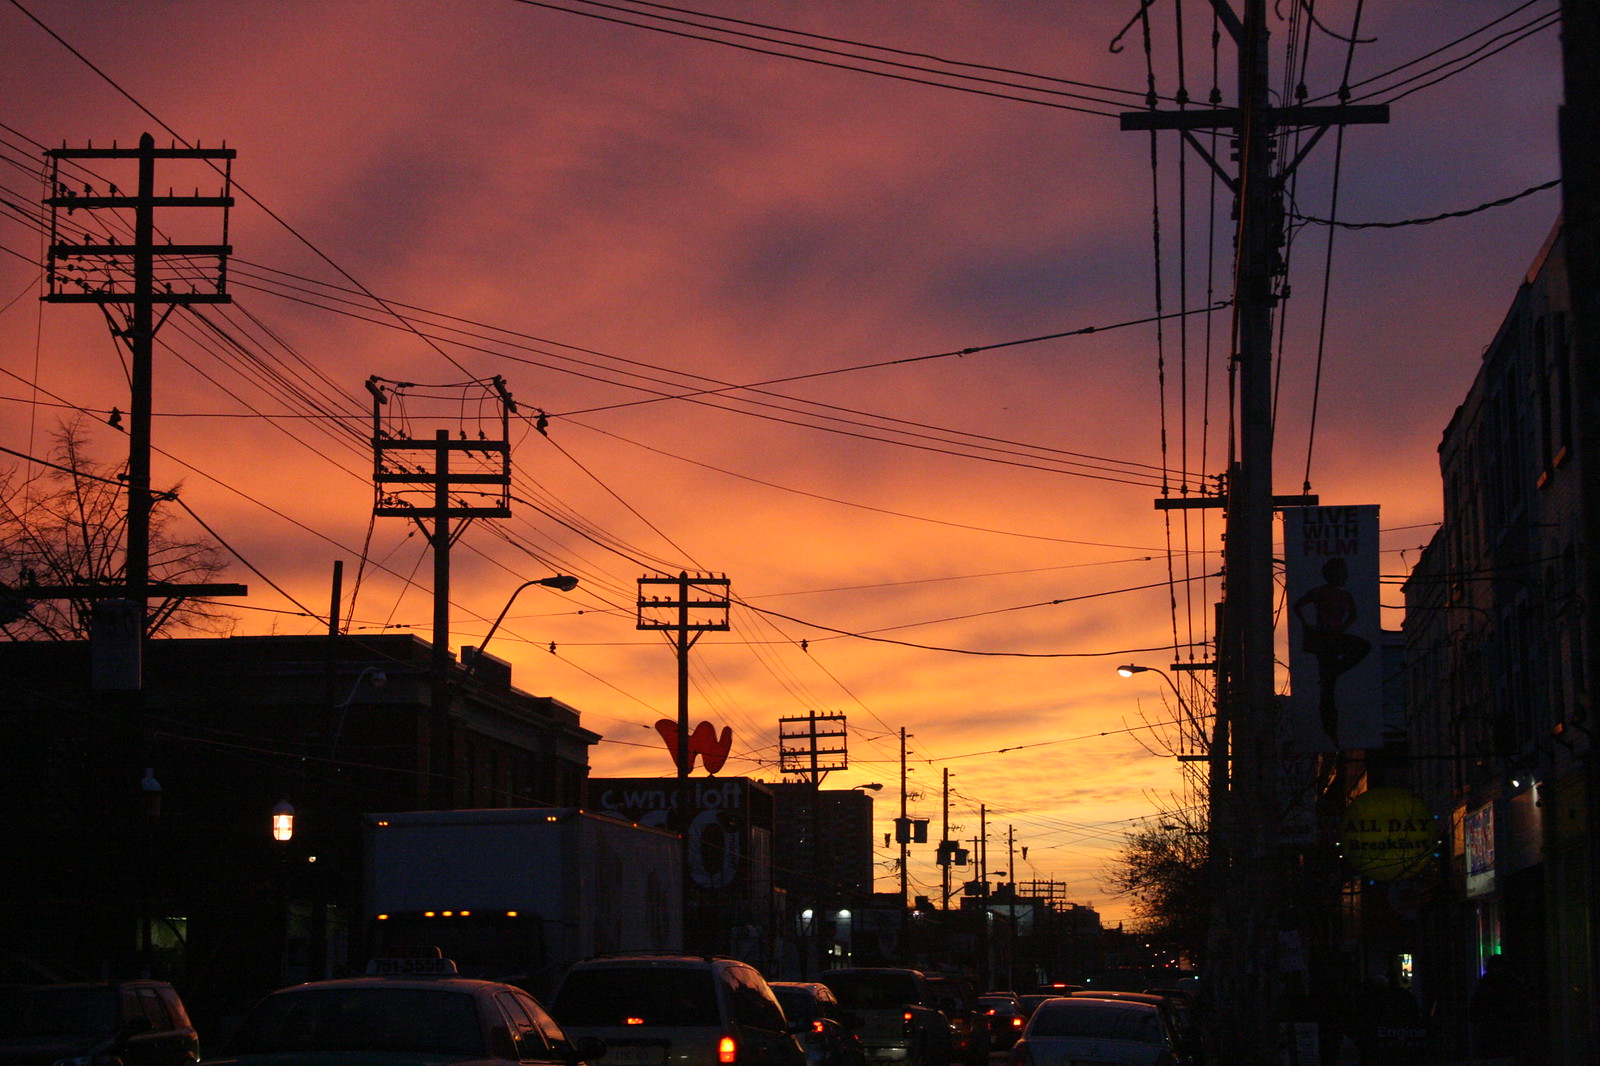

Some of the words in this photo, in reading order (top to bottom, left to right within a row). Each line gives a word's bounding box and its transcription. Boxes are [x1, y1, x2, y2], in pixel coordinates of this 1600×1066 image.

[1303, 507, 1358, 524] LIVE
[1302, 524, 1358, 539] WITH
[1303, 539, 1358, 556] FILM
[695, 782, 742, 809] loft
[1345, 819, 1381, 833] ALL
[1388, 819, 1430, 833] DAY
[1377, 1026, 1427, 1041] Engine
